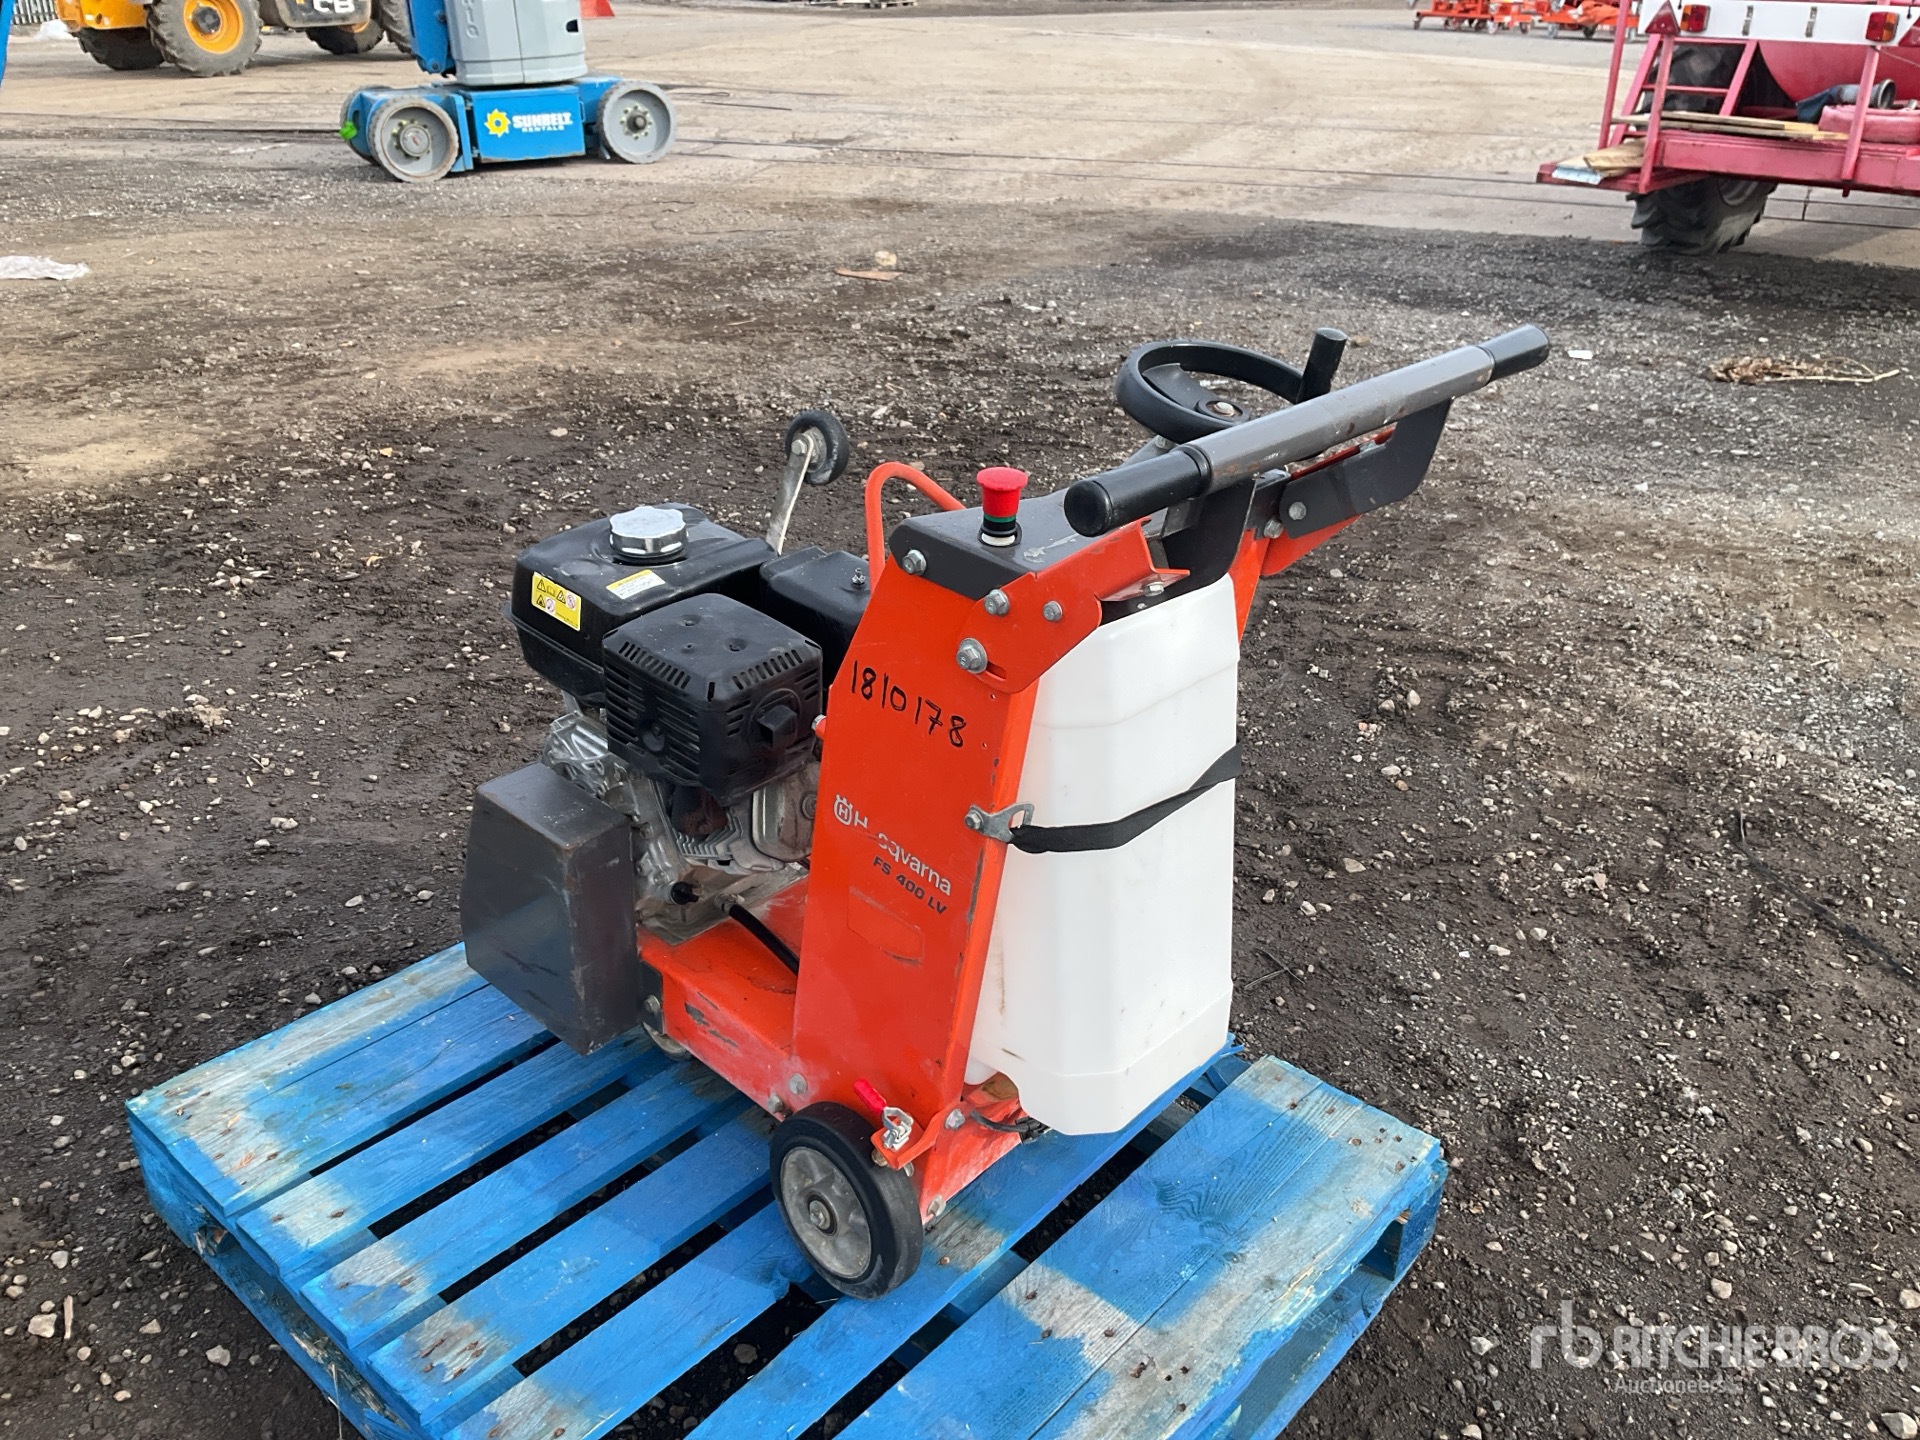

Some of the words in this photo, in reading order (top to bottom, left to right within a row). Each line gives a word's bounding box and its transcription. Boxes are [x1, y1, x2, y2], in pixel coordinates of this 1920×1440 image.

[512, 112, 573, 128] SUNBELT
[852, 660, 967, 748] 1810178
[853, 810, 951, 896] Hsqvarna
[873, 856, 892, 875] FS
[895, 874, 925, 900] 400
[927, 896, 947, 914] LV
